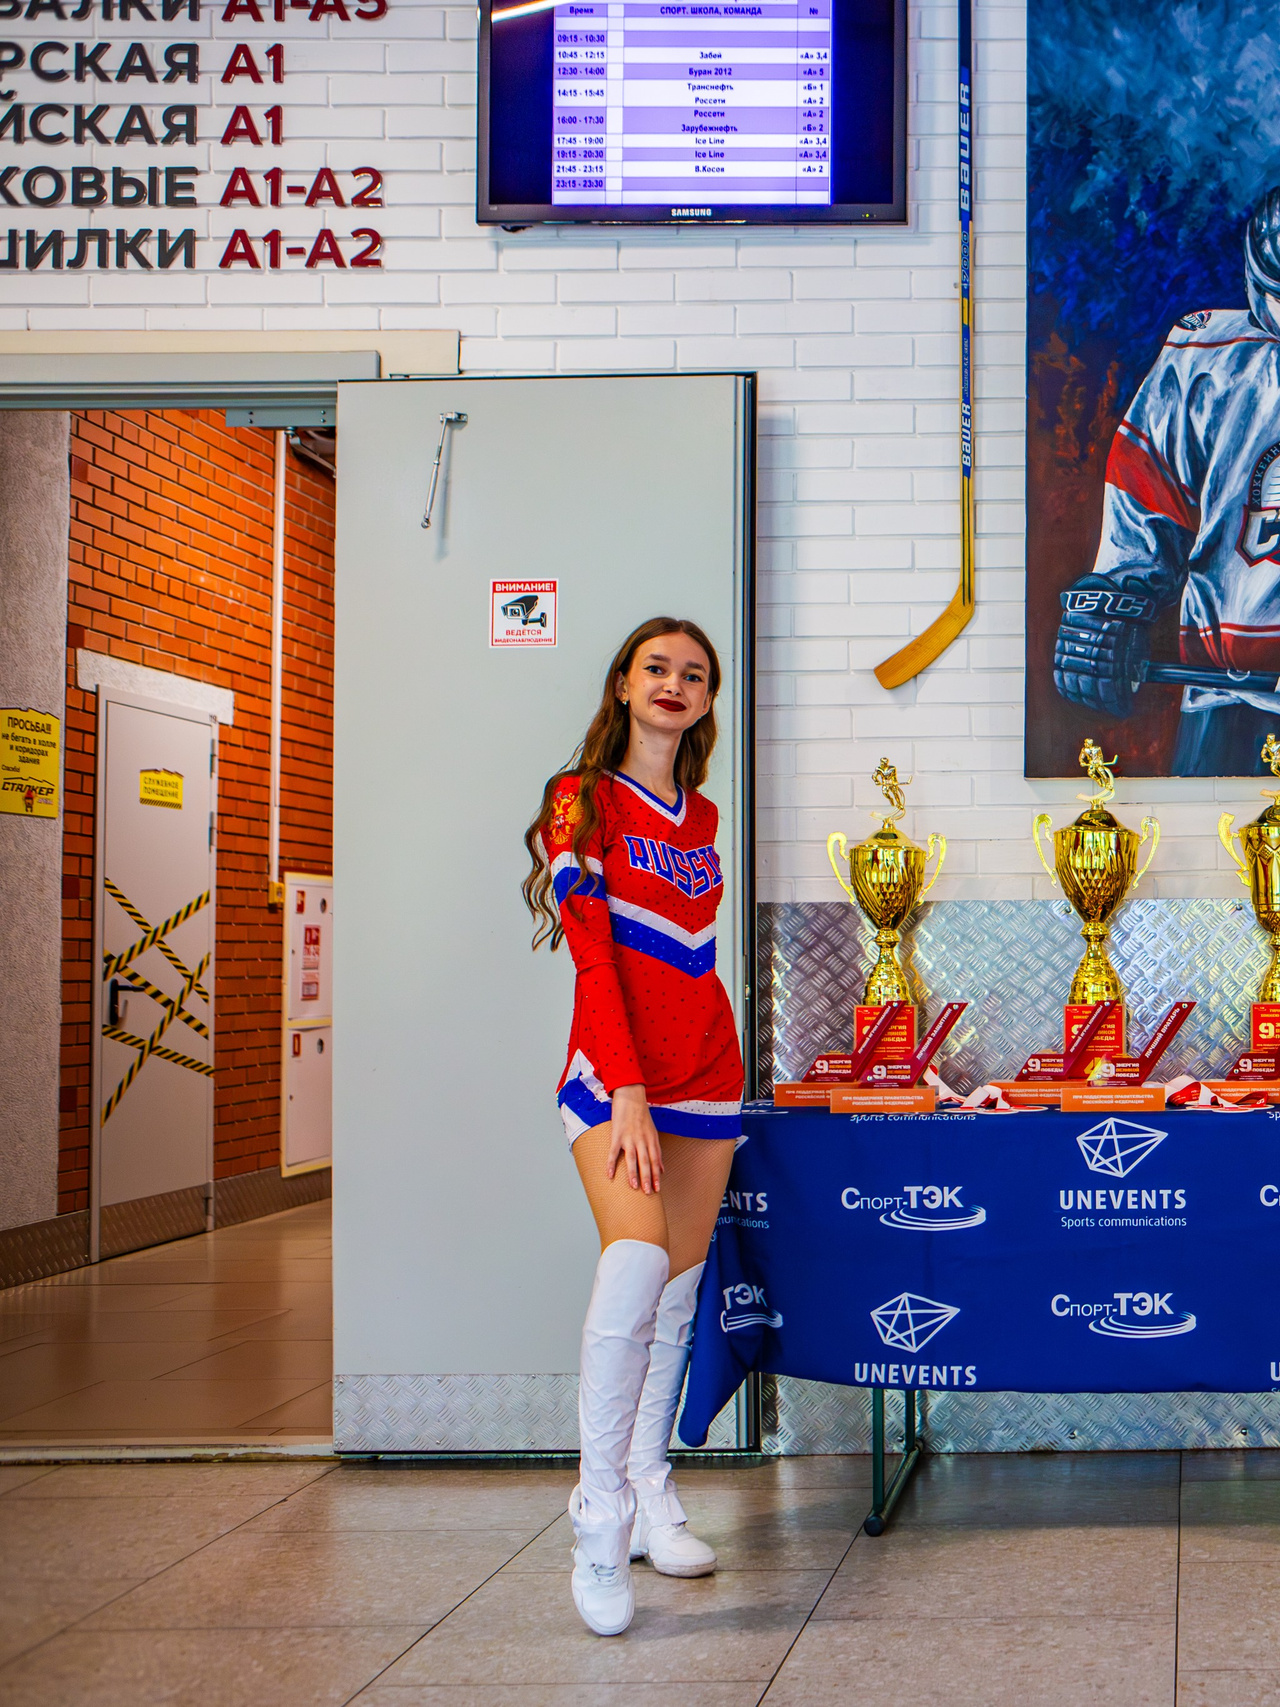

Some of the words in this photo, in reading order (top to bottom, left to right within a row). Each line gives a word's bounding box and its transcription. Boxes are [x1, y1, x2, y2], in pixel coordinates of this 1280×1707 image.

[569, 6, 594, 15] Время
[660, 6, 688, 15] СПОРТ.
[691, 7, 722, 16] ШКОЛА,
[724, 7, 762, 16] КОМАНДА
[557, 34, 578, 42] 09:15
[585, 34, 605, 42] 10:30
[816, 52, 828, 60] 3,4
[0, 41, 200, 83] РСКАЯ
[220, 43, 285, 83] А1
[558, 67, 577, 75] 12:30
[585, 67, 604, 75] 14:00
[689, 68, 712, 76] Буран
[687, 83, 734, 92] Транснефть
[558, 89, 577, 97] 14:15
[585, 89, 604, 97] 15:45
[0, 89, 198, 145] ЙСКАЯ
[220, 104, 284, 145] А1
[557, 116, 577, 124] 16:00
[584, 116, 604, 124] 17:30
[681, 124, 738, 133] Зарубежнефть
[819, 124, 823, 132] 2
[815, 138, 827, 146] 3,4
[960, 83, 970, 212] BAUER
[557, 150, 576, 158] 19:15
[583, 150, 604, 158] 20:30
[815, 151, 827, 159] 3,4
[556, 165, 576, 173] 21:45
[583, 165, 603, 173] 23:15
[556, 180, 576, 188] 23:15
[583, 180, 603, 188] 23:30
[671, 208, 712, 217] SAMSUNG
[961, 402, 972, 467] BAUER
[495, 583, 554, 592] ВНИМАНИЕ!
[506, 628, 542, 636] ВЕДЁТСЯ
[2, 732, 9, 740] не
[11, 732, 31, 744] бегать
[38, 739, 56, 748] холле
[15, 745, 48, 757] коридорах
[18, 755, 40, 765] здания
[2, 782, 55, 796] СТАЛКЕР
[1144, 1032, 1161, 1058] ЛУЧШИЙ
[1160, 1008, 1180, 1033] ВРАТАРЬ
[1259, 1023, 1275, 1039] 9
[916, 1037, 932, 1060] ЛУЧШИЙ
[873, 1065, 886, 1079] 9
[1102, 1063, 1115, 1078] 9
[1059, 1189, 1187, 1210] UNEVENTS
[1061, 1216, 1095, 1229] Sports
[1098, 1215, 1187, 1227] communications
[854, 1363, 977, 1386] UNEVENTS
